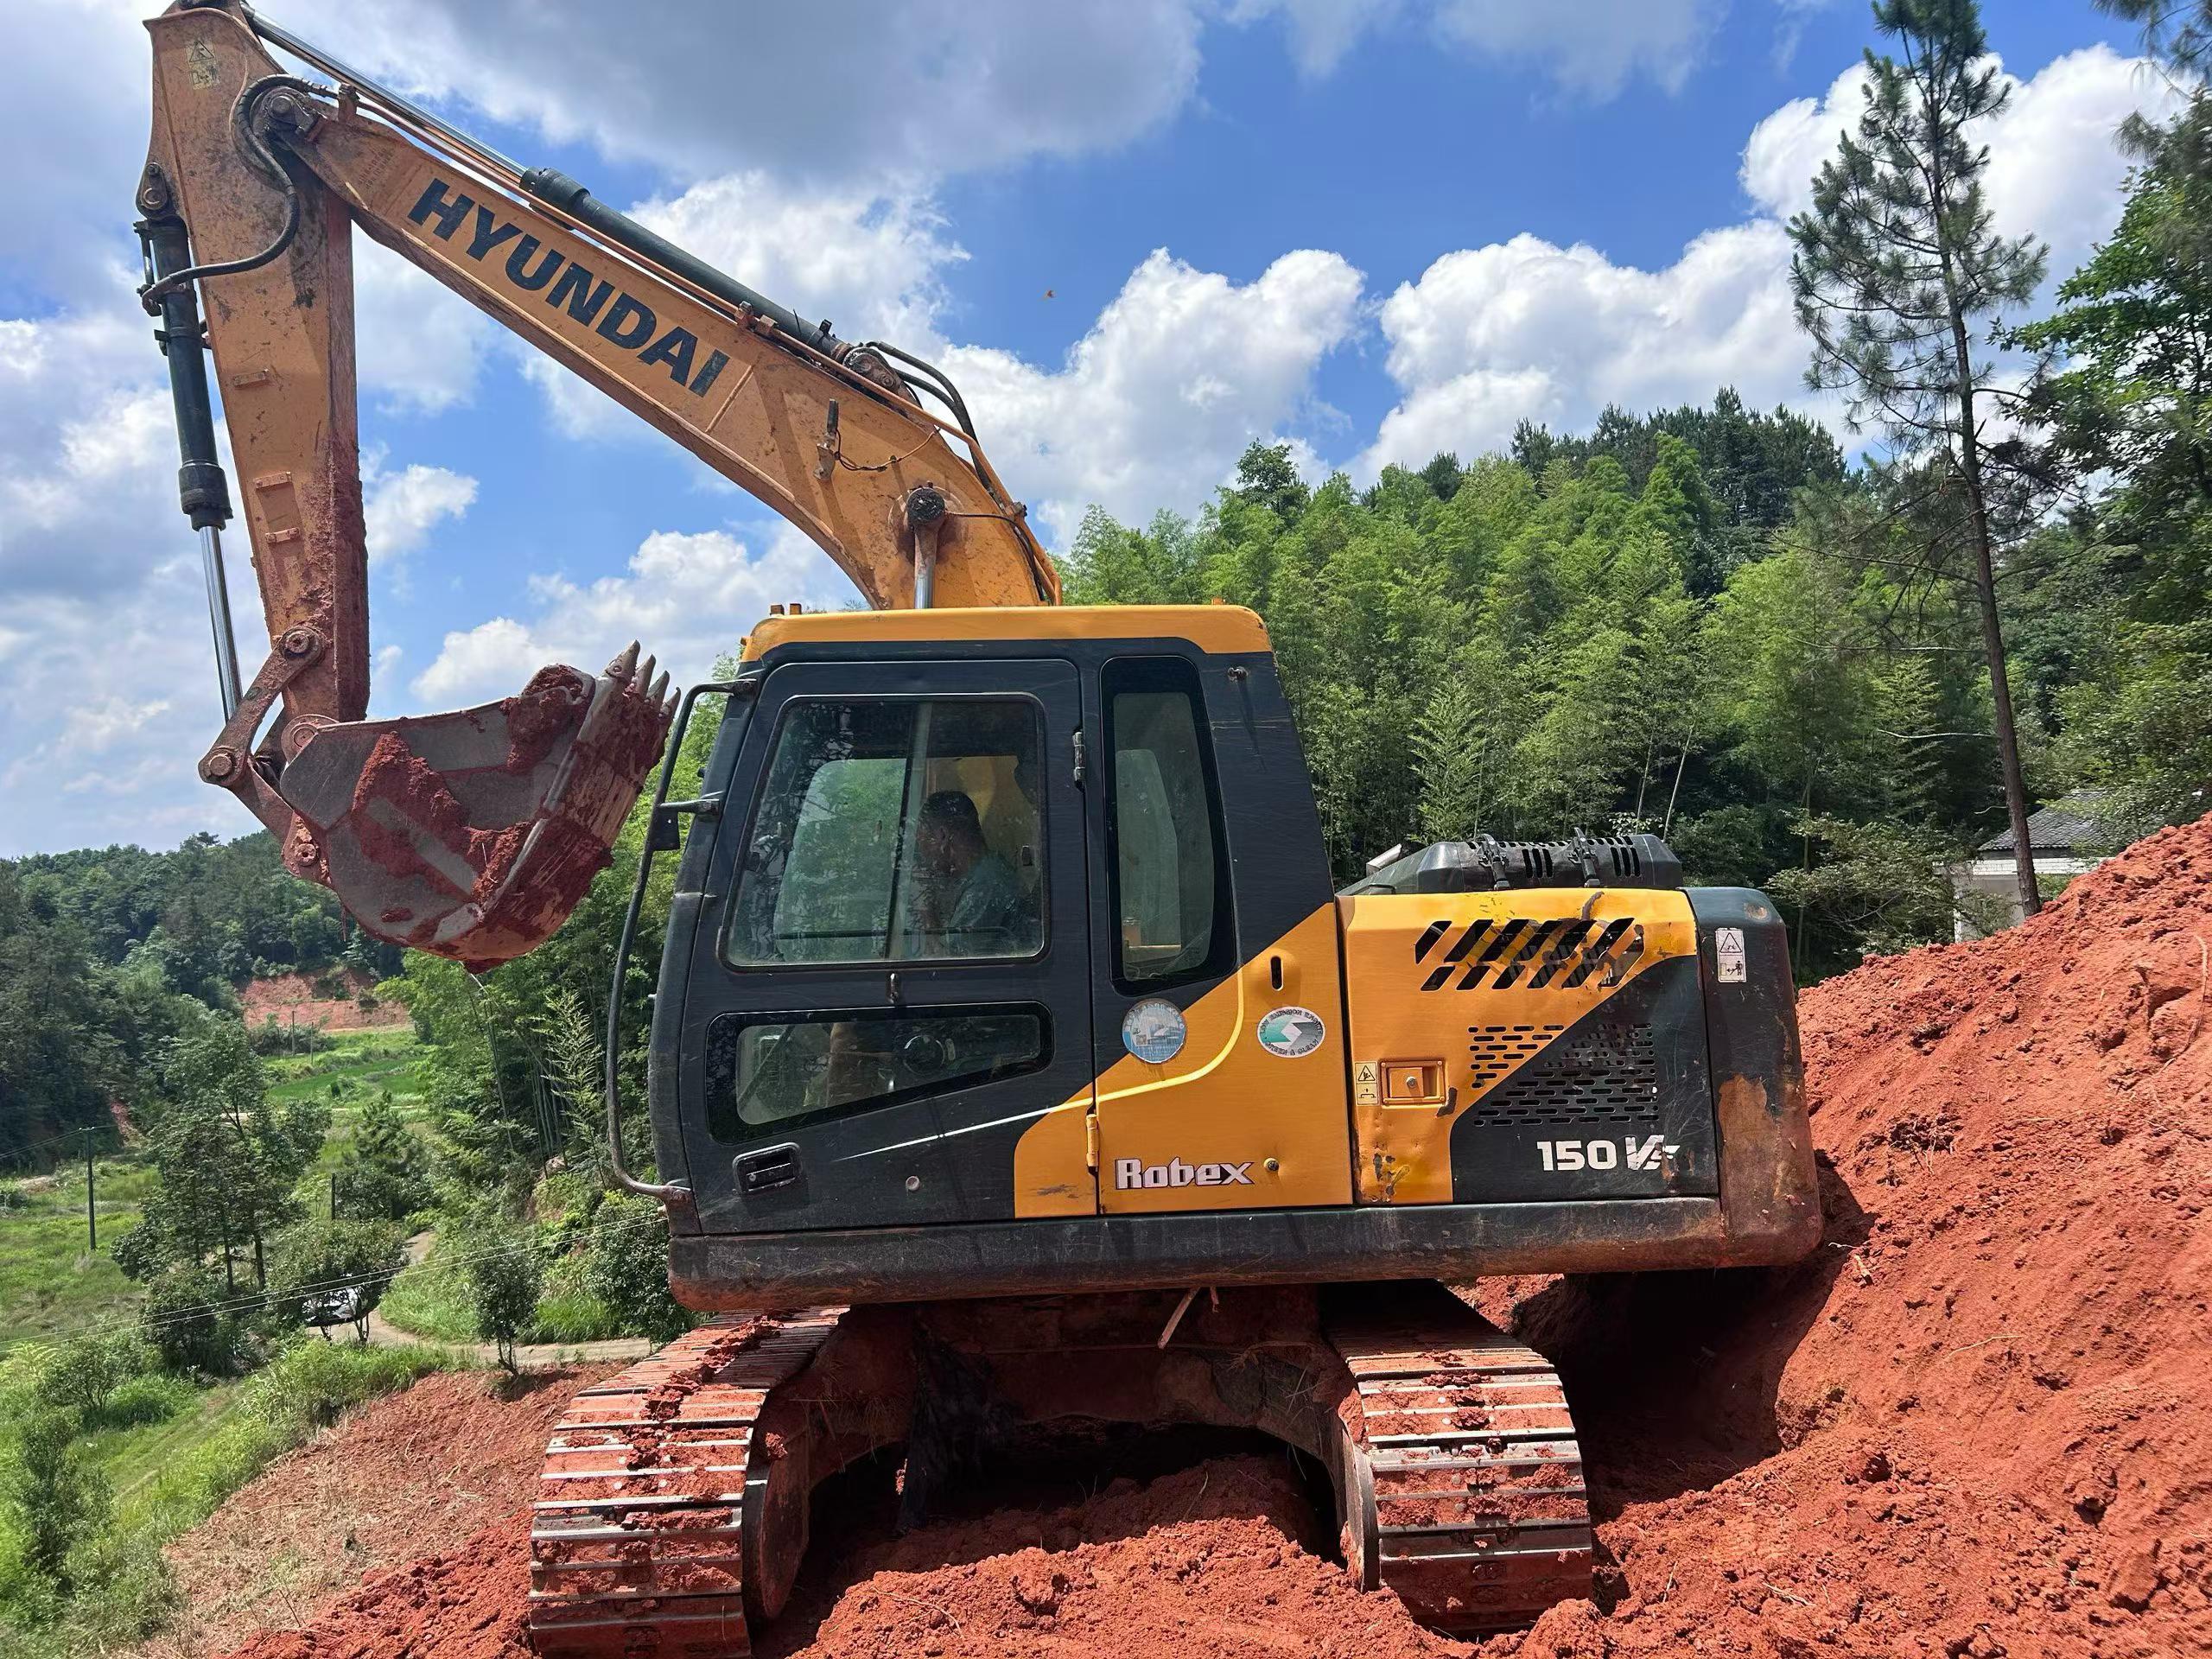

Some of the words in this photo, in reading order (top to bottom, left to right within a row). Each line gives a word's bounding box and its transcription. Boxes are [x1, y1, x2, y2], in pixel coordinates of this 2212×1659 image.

[407, 178, 730, 397] HYUNDAI
[1536, 1140, 1617, 1171] 150
[1115, 1156, 1255, 1190] Robex
